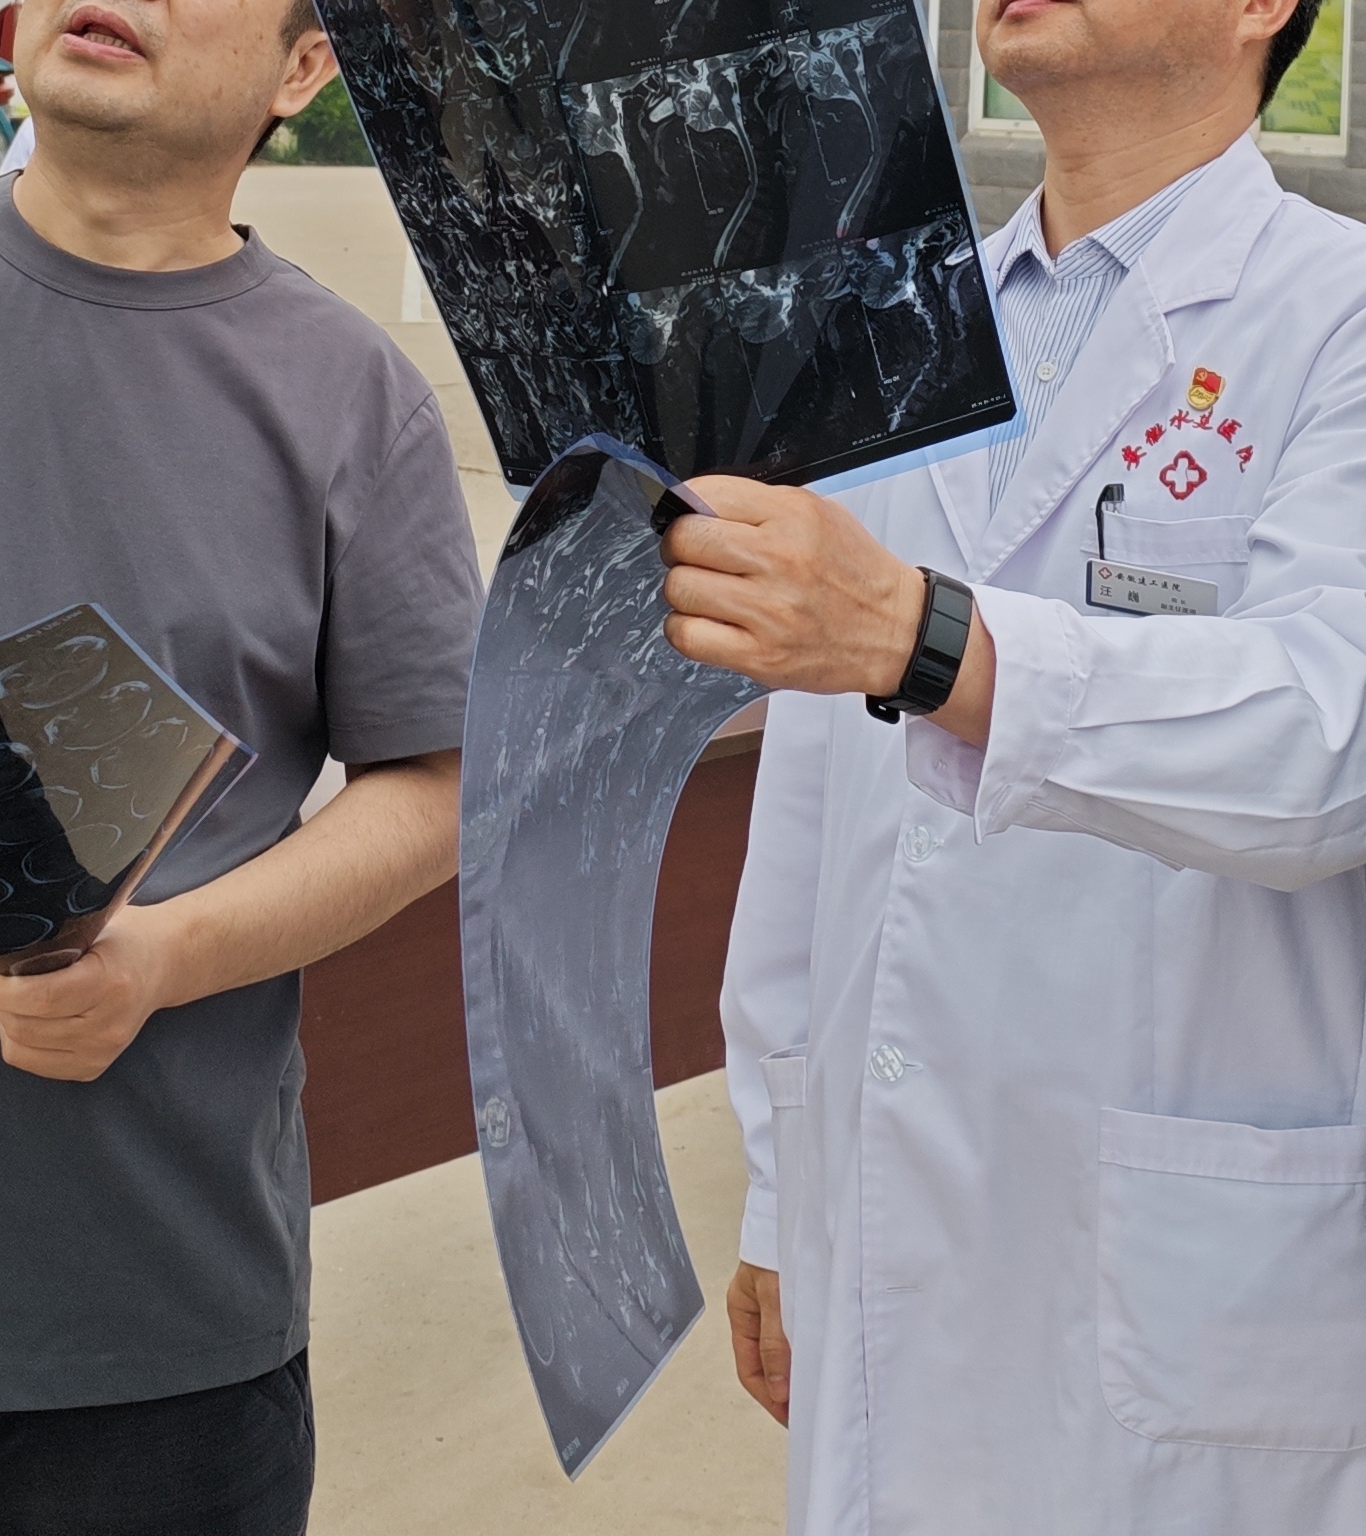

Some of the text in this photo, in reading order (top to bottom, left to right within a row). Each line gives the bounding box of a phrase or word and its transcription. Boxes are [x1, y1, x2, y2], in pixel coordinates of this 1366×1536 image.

[1114, 571, 1182, 592] 安徽建工医院
